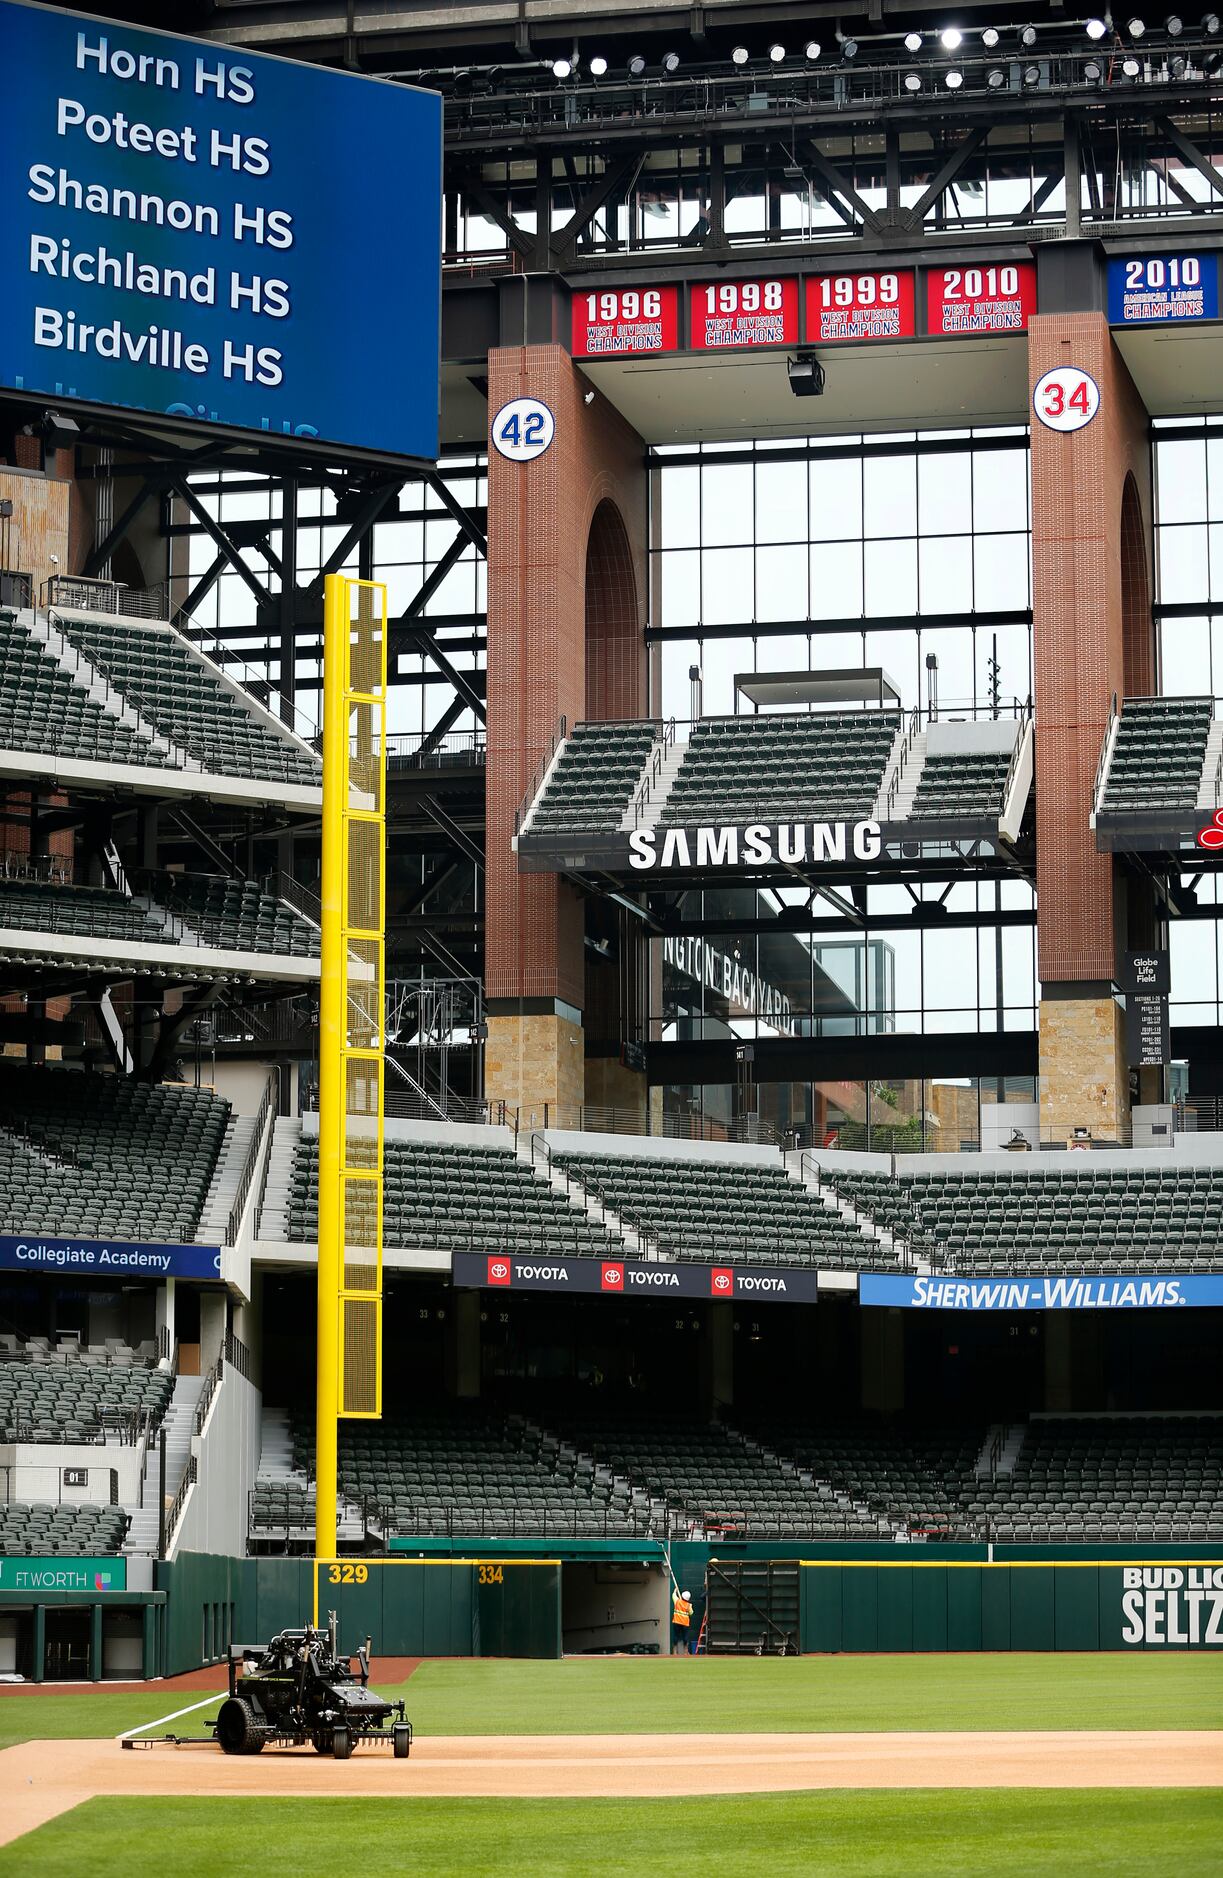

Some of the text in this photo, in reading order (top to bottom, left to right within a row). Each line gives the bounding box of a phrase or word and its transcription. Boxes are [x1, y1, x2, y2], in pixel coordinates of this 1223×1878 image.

[76, 32, 255, 104] Horn HS
[57, 98, 270, 176] Poteet HS
[28, 163, 293, 249] Shannon HS
[29, 234, 290, 318] Richland HS
[1125, 257, 1200, 289] 2010
[820, 274, 898, 307] 1999
[943, 267, 1018, 299] 2010
[586, 290, 661, 322] 1996
[705, 281, 782, 314] 1998
[1124, 288, 1204, 305] AMERICAN LEAGUE
[820, 308, 899, 323] WEST DIVISION
[942, 301, 1021, 316] WEST DIVISION
[1124, 300, 1204, 319] CHAMPIONS
[587, 322, 662, 338] WEST DIVISION
[705, 315, 783, 330] WEST DIVISION
[820, 320, 900, 339] CHAMPIONS
[942, 313, 1022, 331] CHAMPIONS
[34, 306, 283, 386] Birdville HS
[586, 334, 662, 352] CHAMPIONS
[705, 327, 784, 346] CHAMPIONS
[1042, 381, 1091, 418] 34
[500, 412, 545, 448] 42
[628, 820, 881, 869] SAMSUNG
[1133, 958, 1158, 967] Globe
[1138, 966, 1154, 975] Life
[1136, 974, 1156, 983] Field
[724, 954, 790, 1035] BACKYARD
[16, 1243, 171, 1270] Collegiate Academy
[515, 1265, 568, 1281] TOYOTA
[628, 1271, 680, 1286] TOYOTA
[737, 1277, 787, 1292] TOYOTA
[500, 1313, 508, 1322] 32
[675, 1320, 684, 1329] 32
[752, 1323, 760, 1332] 31
[1010, 1327, 1018, 1336] 31
[69, 1472, 79, 1482] 01
[30, 1572, 87, 1587] WORTH
[328, 1564, 368, 1584] 329
[479, 1565, 503, 1584] 334
[1123, 1567, 1184, 1589] BUD
[1122, 1589, 1223, 1643] SELTZ
